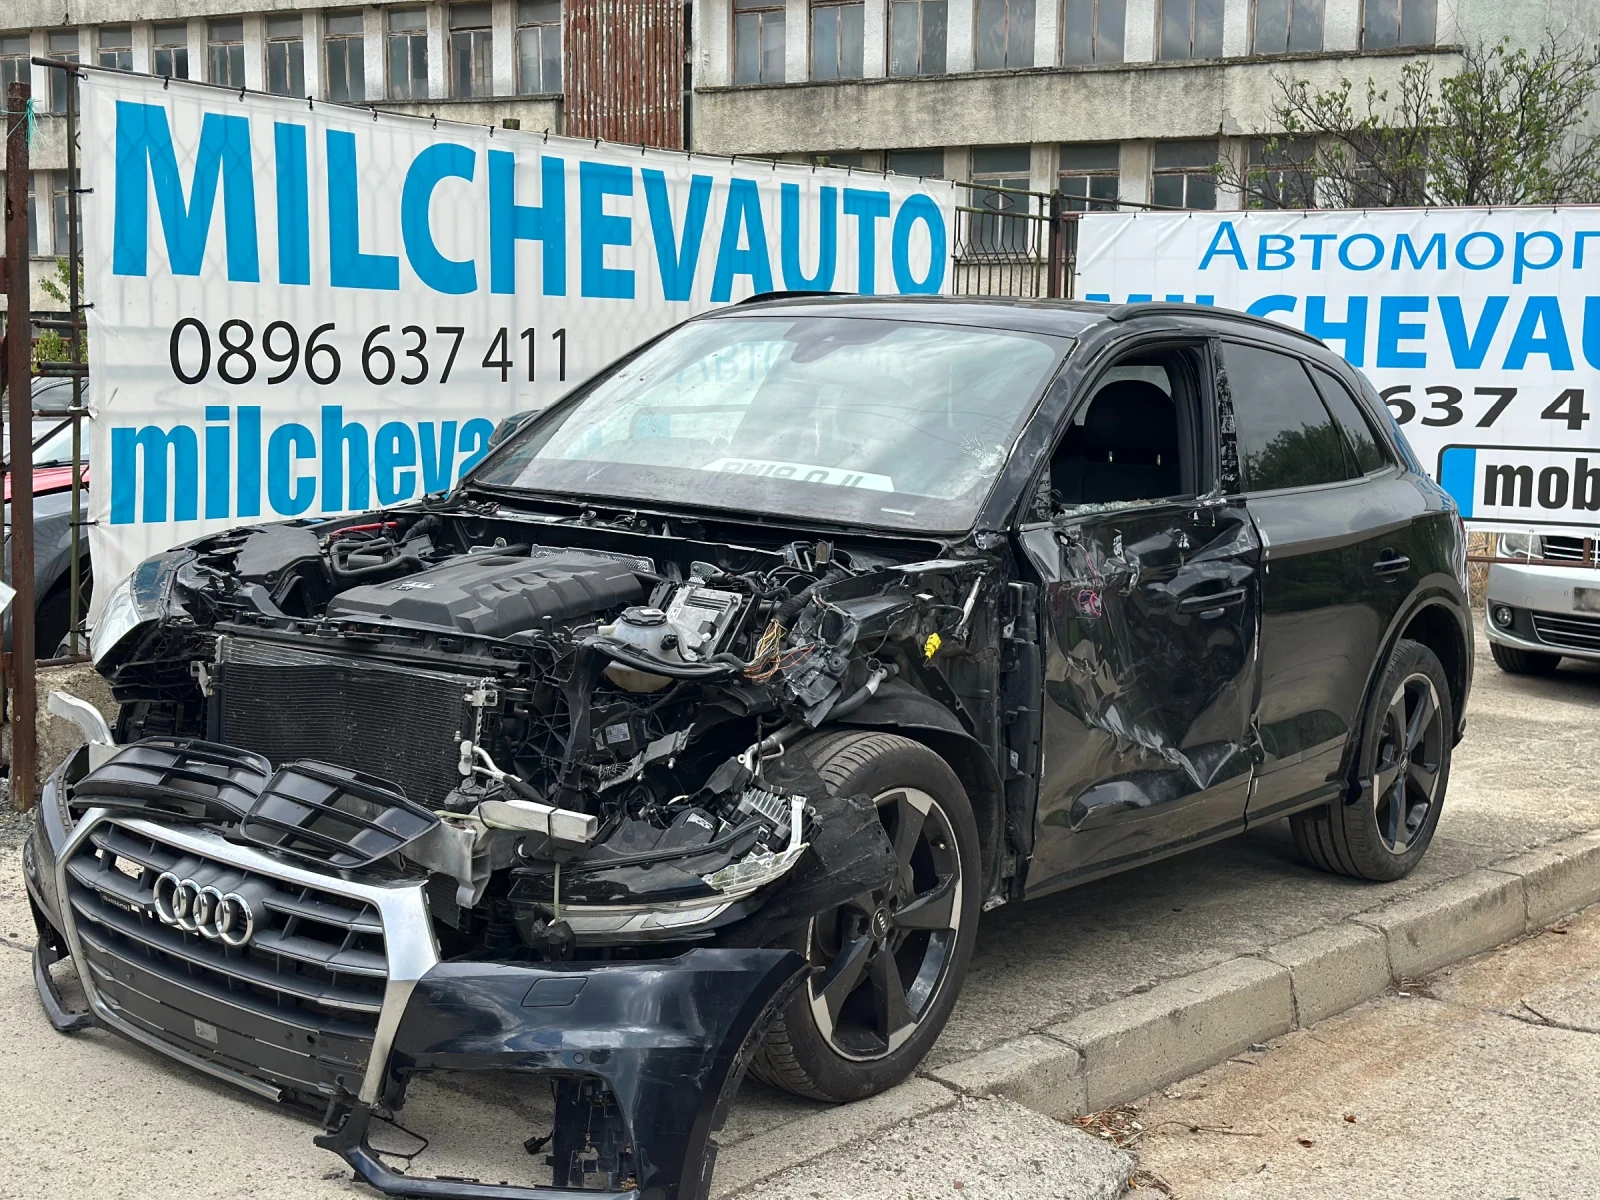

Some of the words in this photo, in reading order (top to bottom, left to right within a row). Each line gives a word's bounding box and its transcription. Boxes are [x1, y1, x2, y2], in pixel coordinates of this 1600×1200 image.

[112, 100, 947, 303] MILCHEVAUTO
[169, 317, 341, 386] 0896
[361, 324, 465, 386] 637
[481, 327, 566, 383] 411
[1378, 385, 1518, 428] 637
[1540, 388, 1590, 431] 4
[1483, 457, 1600, 512] mob
